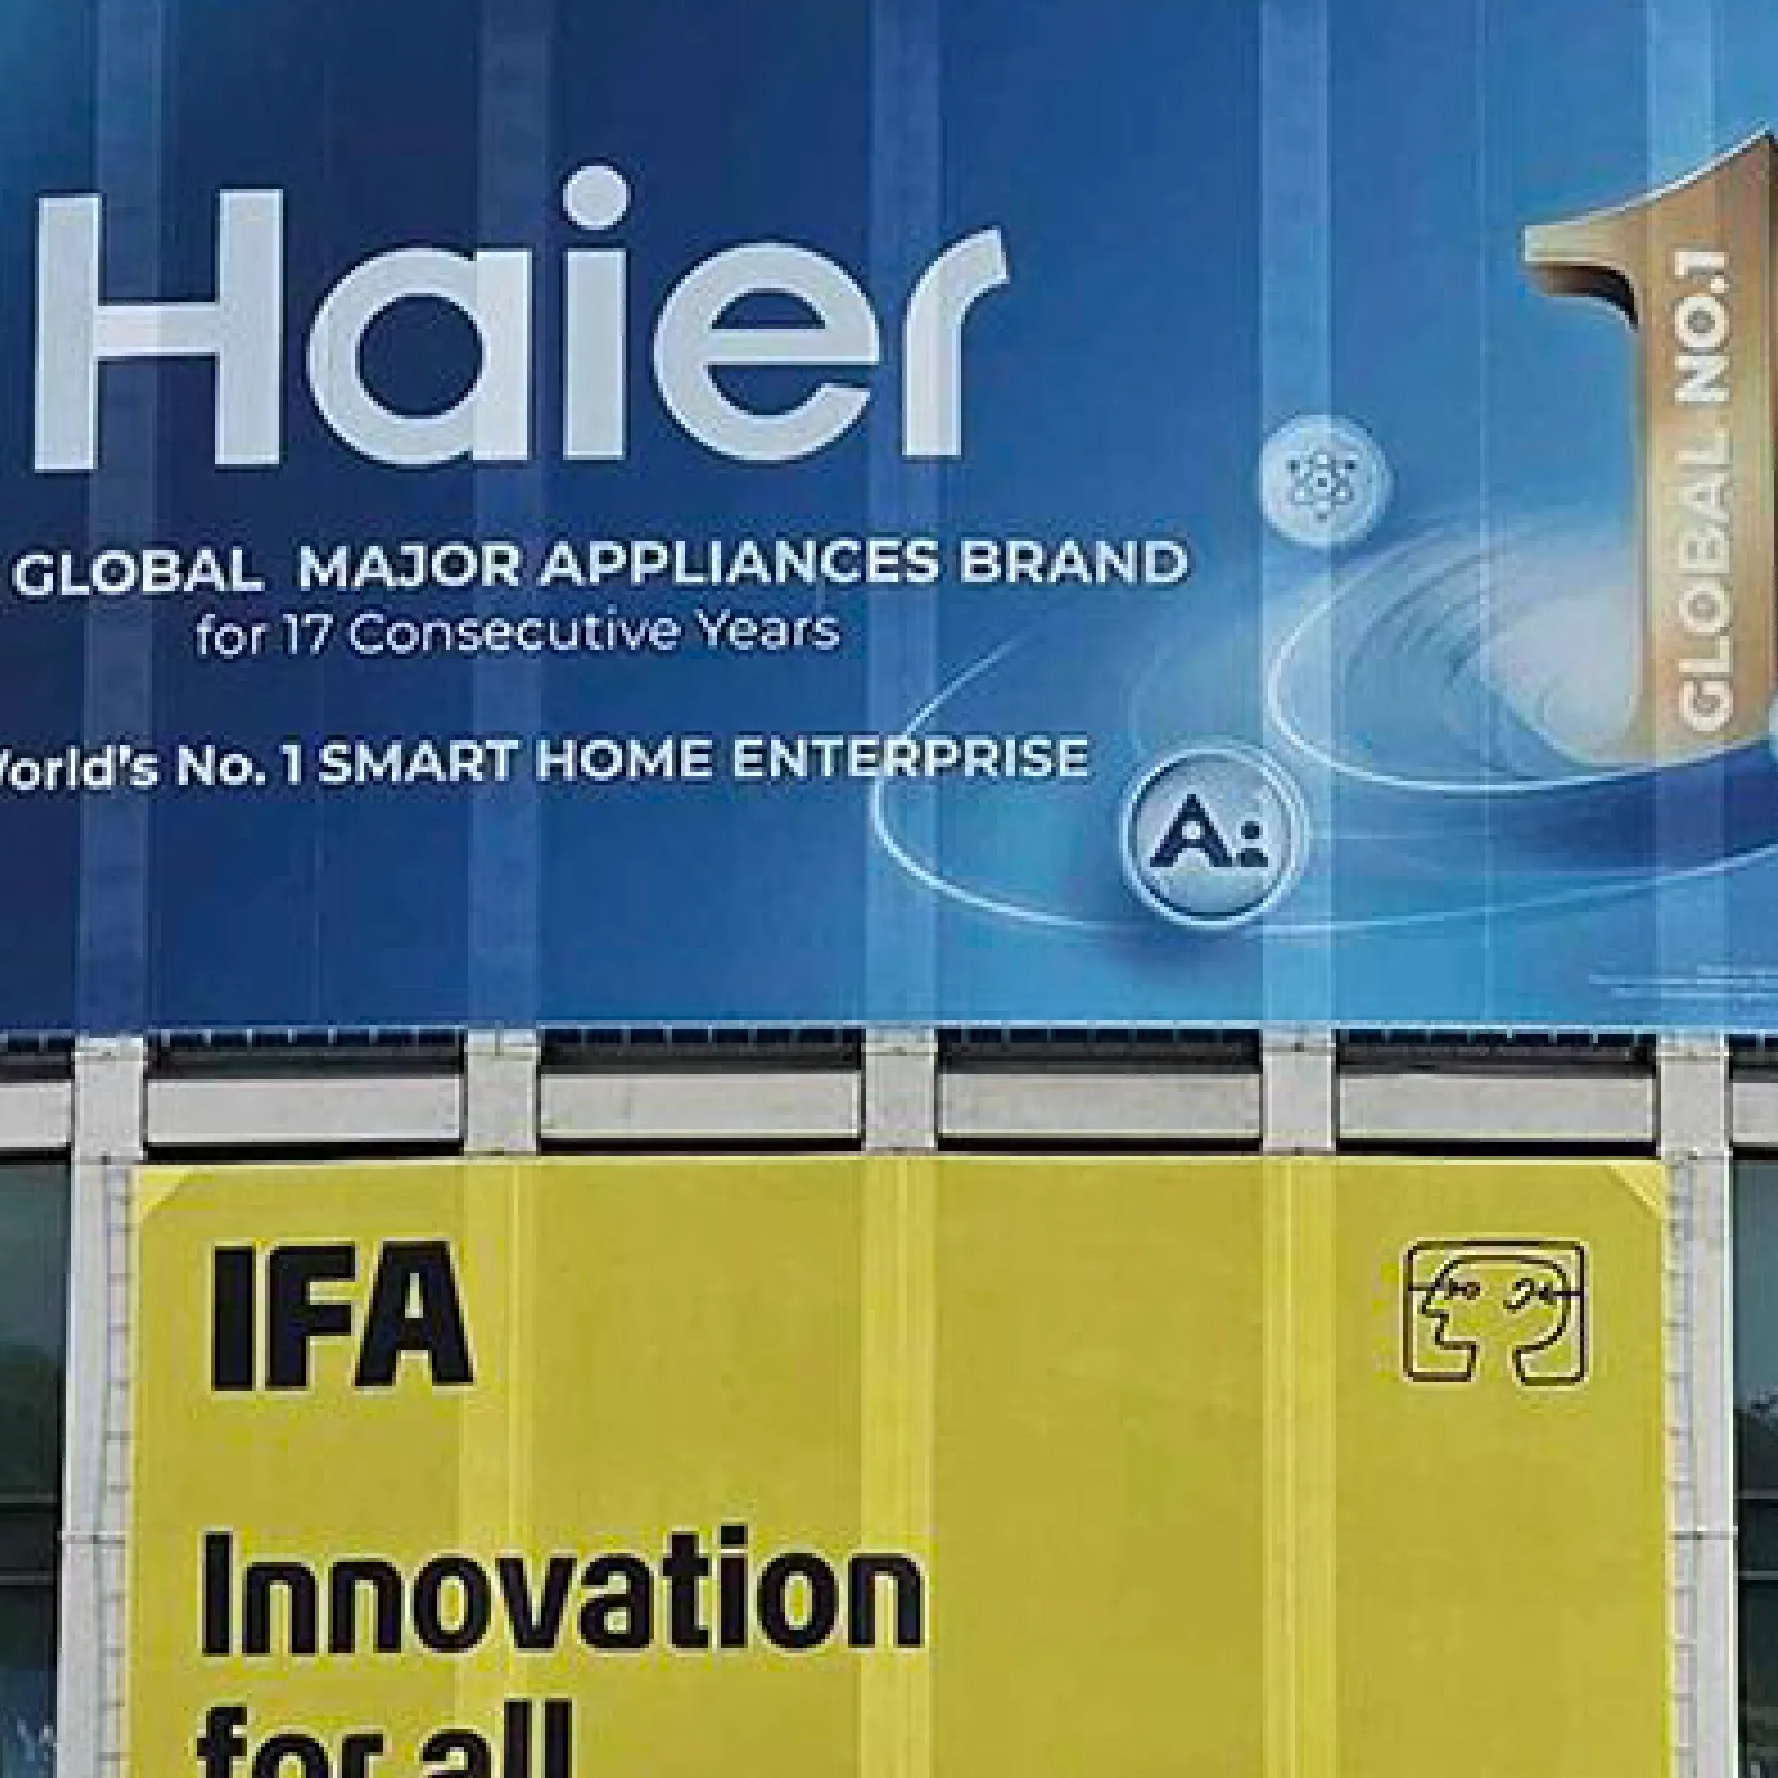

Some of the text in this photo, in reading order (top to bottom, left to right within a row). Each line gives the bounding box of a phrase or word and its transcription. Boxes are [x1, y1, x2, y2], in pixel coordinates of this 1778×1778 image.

[33, 165, 1010, 472] Haier
[12, 545, 265, 598] GLOBAL
[298, 540, 521, 592] MAJOR
[539, 538, 941, 587] APPLIANCES
[959, 538, 1191, 586] BRAND
[196, 605, 842, 659] for 17 Consecutive Years
[1677, 427, 1735, 732] GLOBAL
[176, 743, 267, 788] No.
[282, 742, 302, 784] 1
[317, 738, 519, 786] SMART
[535, 737, 714, 781] HOME
[733, 735, 1090, 779] ENTERPRISE
[209, 1240, 475, 1393] IFA
[201, 1524, 926, 1656] Innovation
